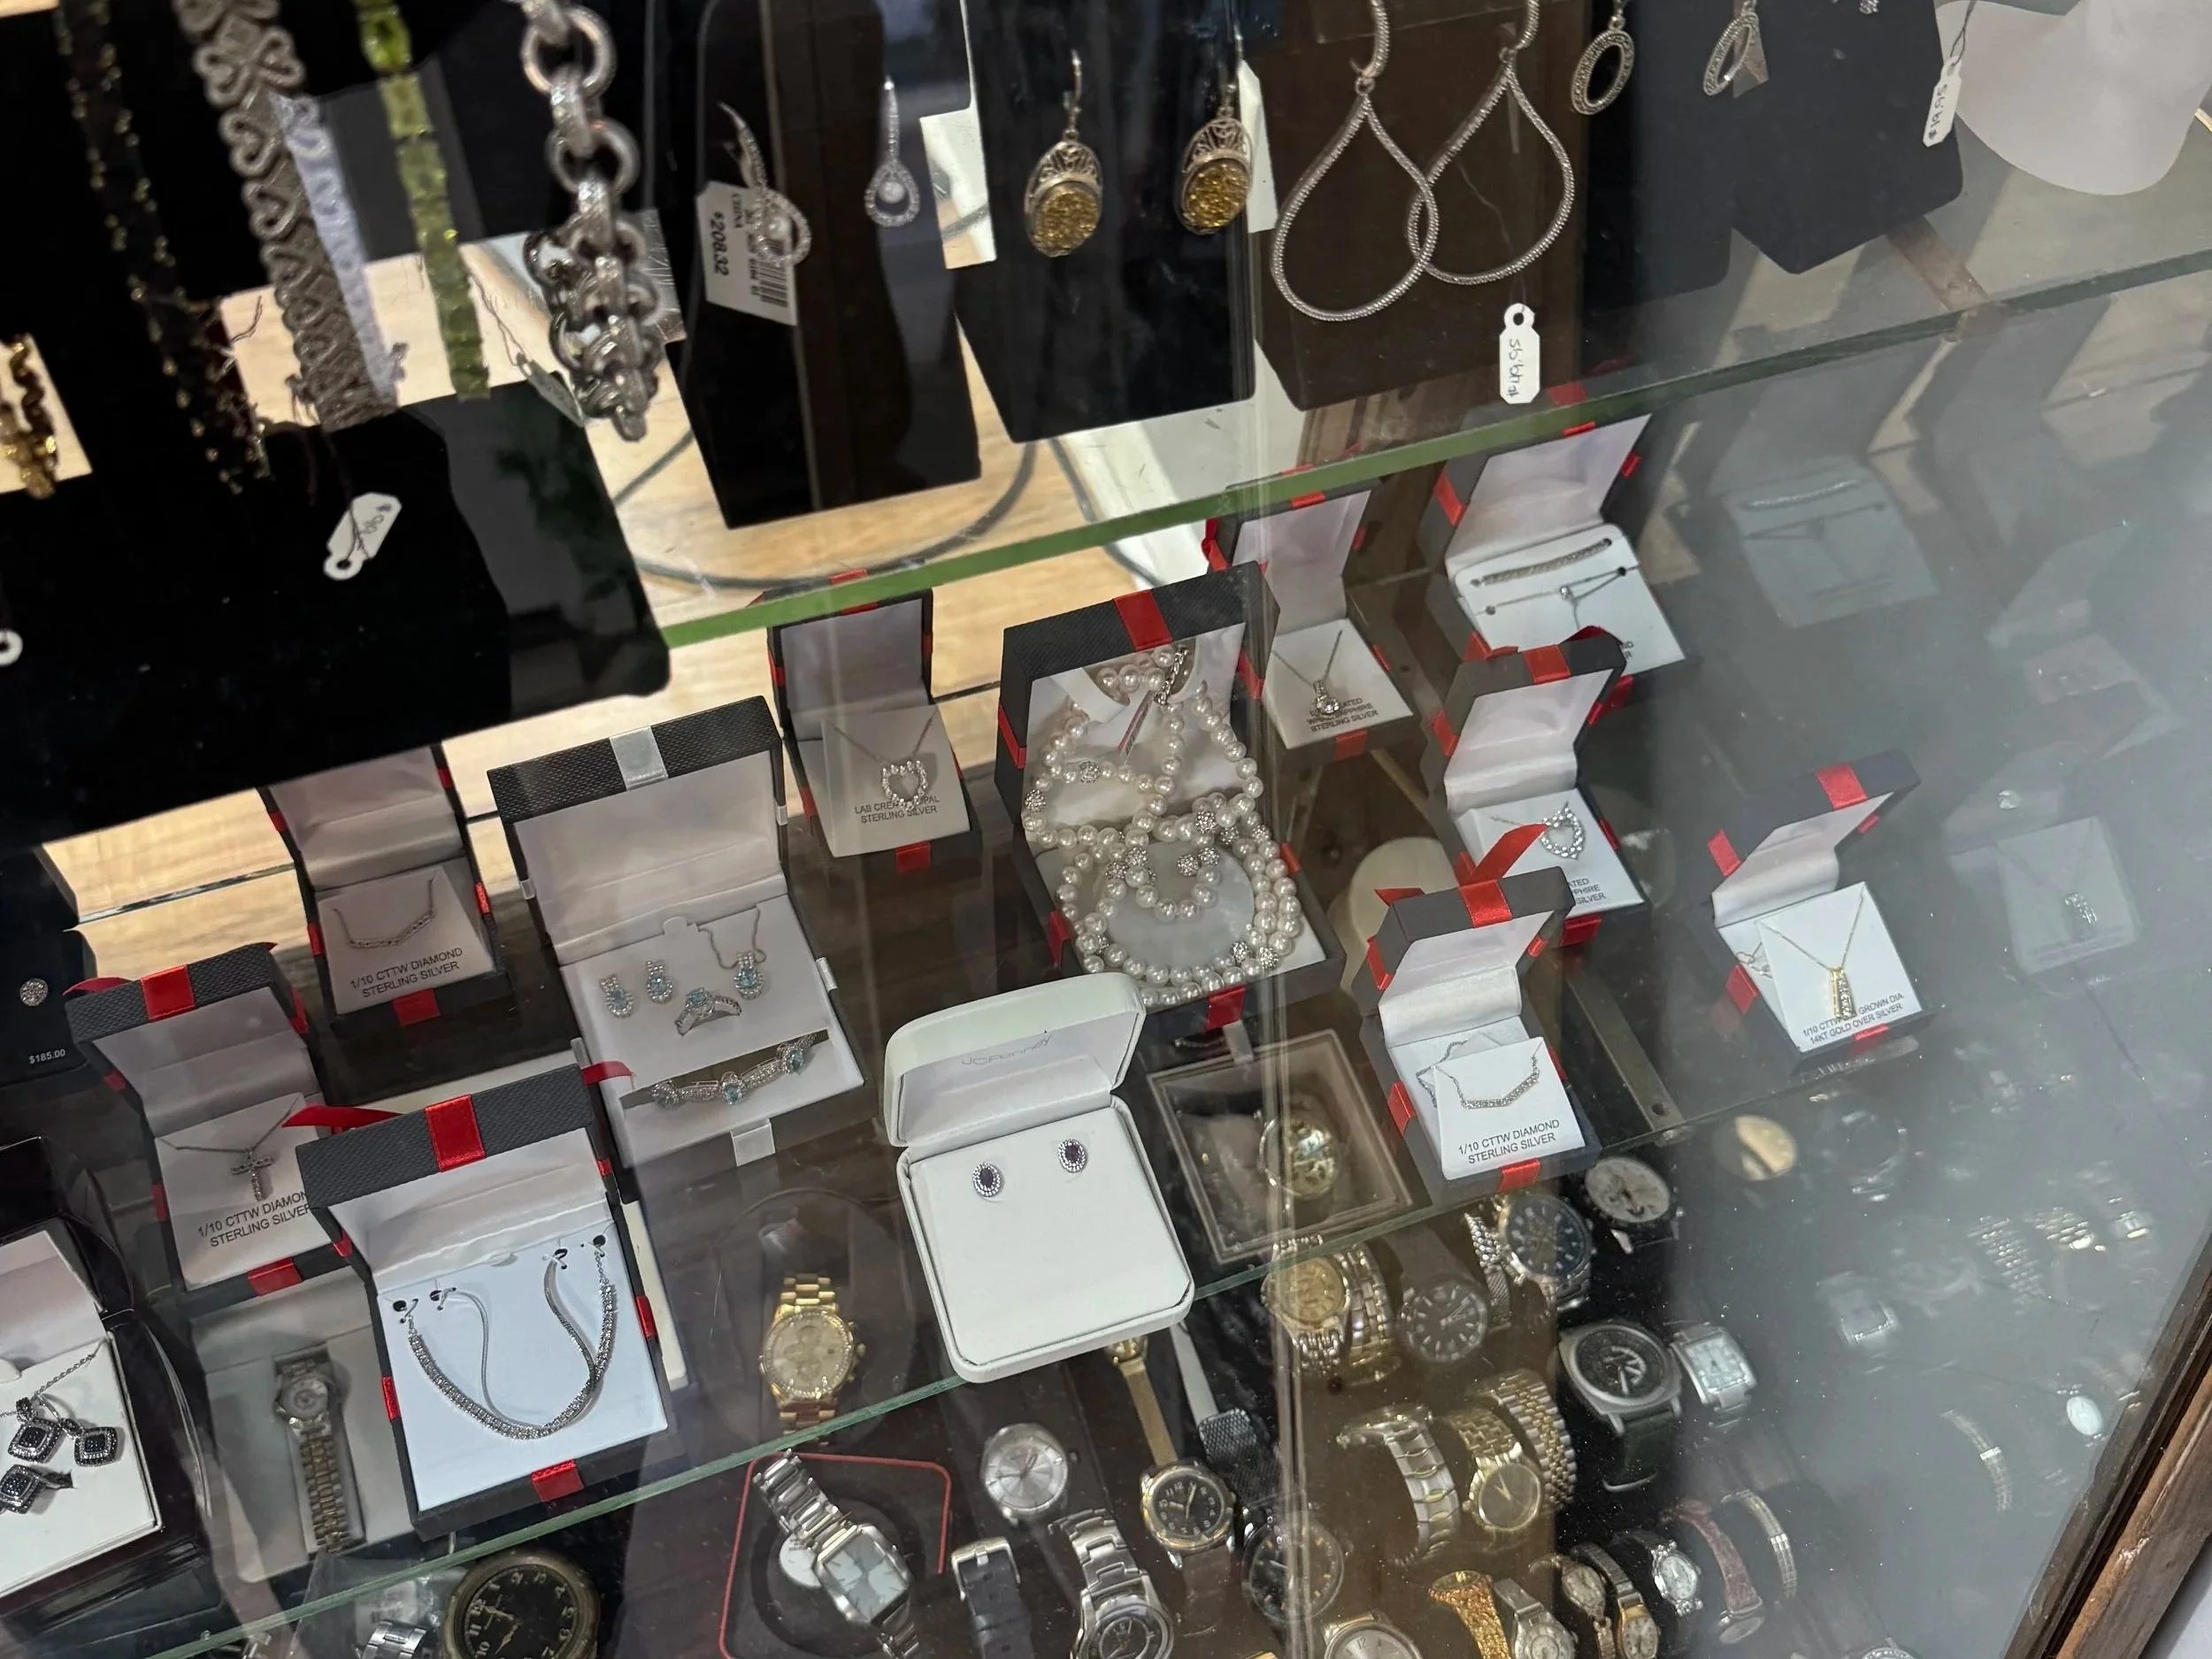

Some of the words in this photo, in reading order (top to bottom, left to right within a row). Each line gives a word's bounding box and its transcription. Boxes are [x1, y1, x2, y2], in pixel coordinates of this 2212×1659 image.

[1350, 710, 1379, 722] SILVER
[855, 803, 872, 814] LAB
[861, 810, 905, 824] STERLING
[906, 805, 938, 817] SILVER
[349, 974, 373, 989] 1/10
[376, 964, 409, 980] CTTW
[411, 948, 463, 970] DIAMOND
[362, 974, 419, 997] STERLING
[420, 961, 460, 980] SILVER
[1858, 998, 1889, 1015] GROWN
[1809, 1031, 1828, 1044] 14KT
[1829, 1023, 1852, 1036] GOLD
[1852, 1014, 1875, 1027] OVER
[1875, 1002, 1903, 1018] SILVER
[28, 1048, 66, 1064] $185.00
[1458, 1141, 1479, 1155] 1/10
[1481, 1133, 1510, 1148] CTTW
[1512, 1119, 1560, 1139] DIAMOND
[1468, 1142, 1518, 1164] STERLING
[1520, 1132, 1556, 1149] SILVER
[197, 1220, 222, 1237] 1/10
[225, 1207, 259, 1227] CTTW
[262, 1191, 308, 1215] DIAMON
[210, 1219, 270, 1248] STERLING
